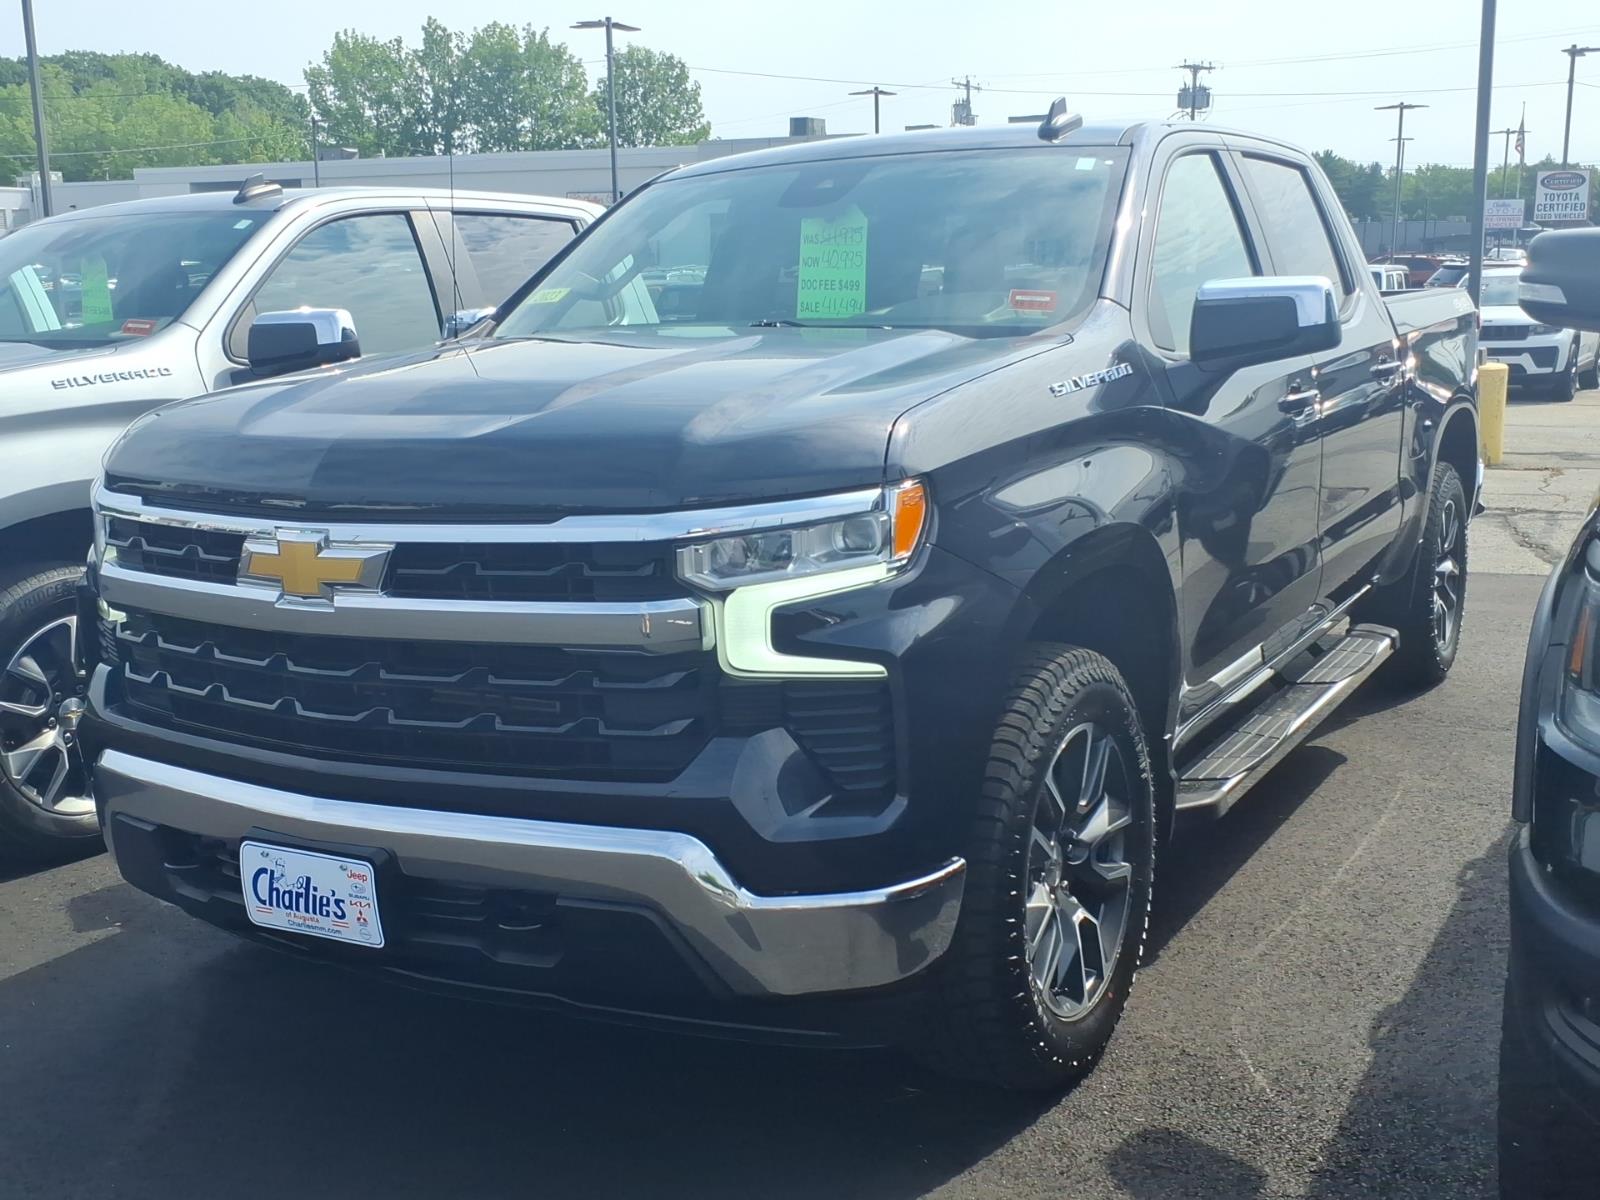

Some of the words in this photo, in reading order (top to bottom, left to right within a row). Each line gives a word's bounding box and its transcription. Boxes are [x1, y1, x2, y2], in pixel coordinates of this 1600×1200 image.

[1543, 192, 1580, 202] TOYOTA
[1486, 207, 1523, 215] OYOTA
[1536, 202, 1586, 213] CERTIFIED
[801, 256, 820, 269] NOW
[801, 279, 818, 290] DOC
[819, 279, 836, 291] FEE
[837, 279, 860, 291] $499
[800, 301, 820, 313] SALE
[51, 367, 173, 389] SILVERADO
[346, 869, 368, 882] Jeep
[252, 867, 347, 921] Charlie's
[294, 912, 320, 924] Augusta
